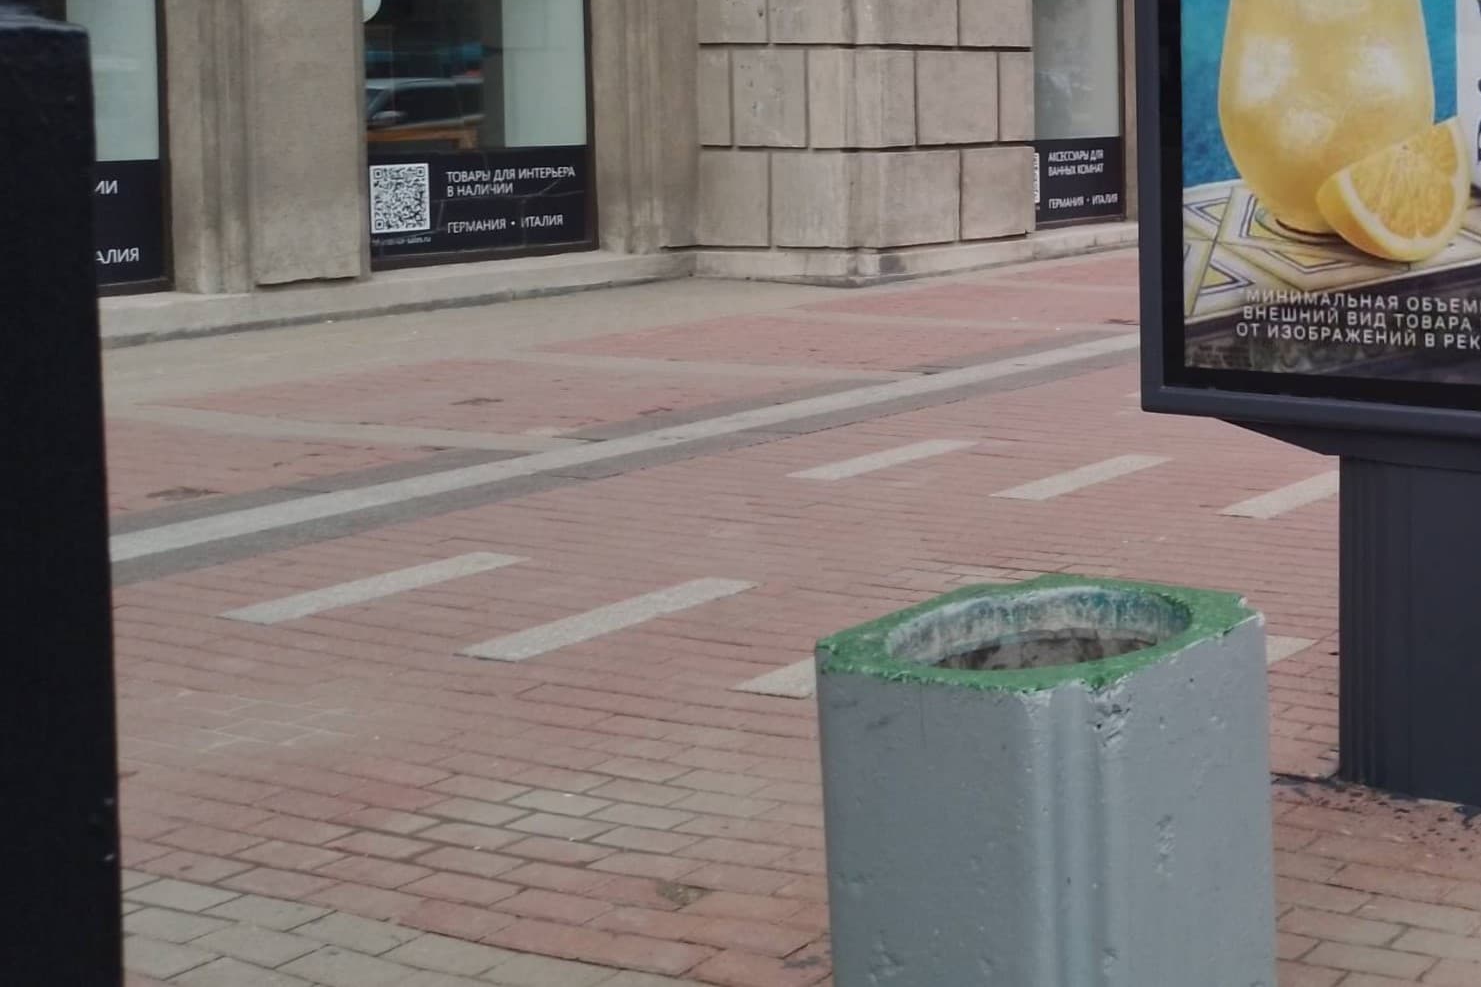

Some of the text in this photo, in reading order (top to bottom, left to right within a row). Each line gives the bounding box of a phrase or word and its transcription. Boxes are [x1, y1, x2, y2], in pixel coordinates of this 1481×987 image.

[446, 166, 576, 183] ТОВАРЫ ДЛЯ ИНТЕРЬЕРА
[447, 183, 514, 197] В НАЛИЧИИ
[447, 214, 564, 234] ГЕРМАНИЯ ИТАЛИЯ
[96, 247, 140, 264] АЛИЯ
[1243, 306, 1339, 325] ВНЕШНИЙ
[1347, 312, 1387, 329] ВИД
[1394, 313, 1472, 331] ТОВАРА
[1236, 323, 1260, 337] ОТ
[1266, 323, 1417, 347] ИЗОБРАЖЕНИЙ
[1425, 334, 1435, 347] В
